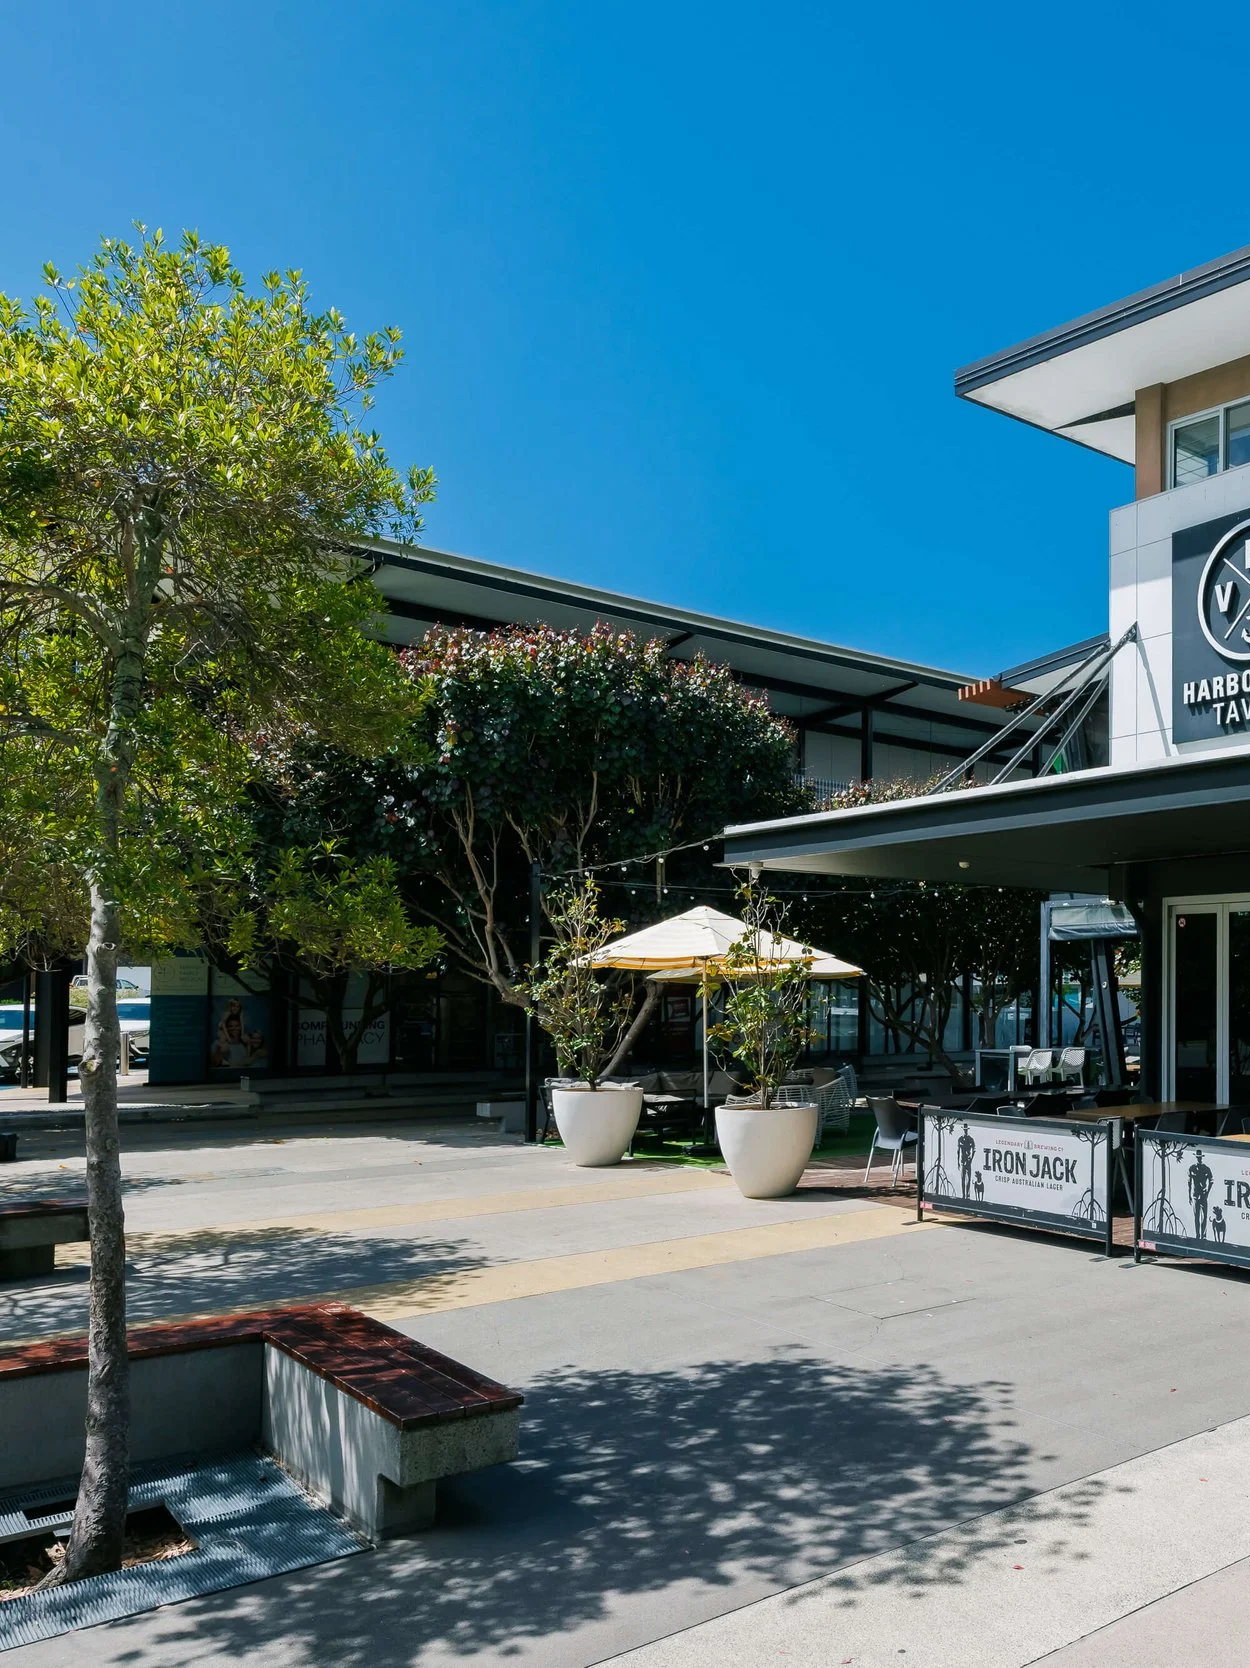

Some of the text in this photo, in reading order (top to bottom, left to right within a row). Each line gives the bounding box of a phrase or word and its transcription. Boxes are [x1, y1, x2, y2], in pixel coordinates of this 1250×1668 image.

[1214, 580, 1235, 614] V
[297, 1032, 385, 1046] PHACY
[995, 1139, 1024, 1148] LEGENDARY
[1033, 1144, 1058, 1152] BREWING
[983, 1148, 1077, 1184] IRON JACK
[995, 1175, 1010, 1183] CRISP
[1012, 1178, 1045, 1189] AUSTRALIAN
